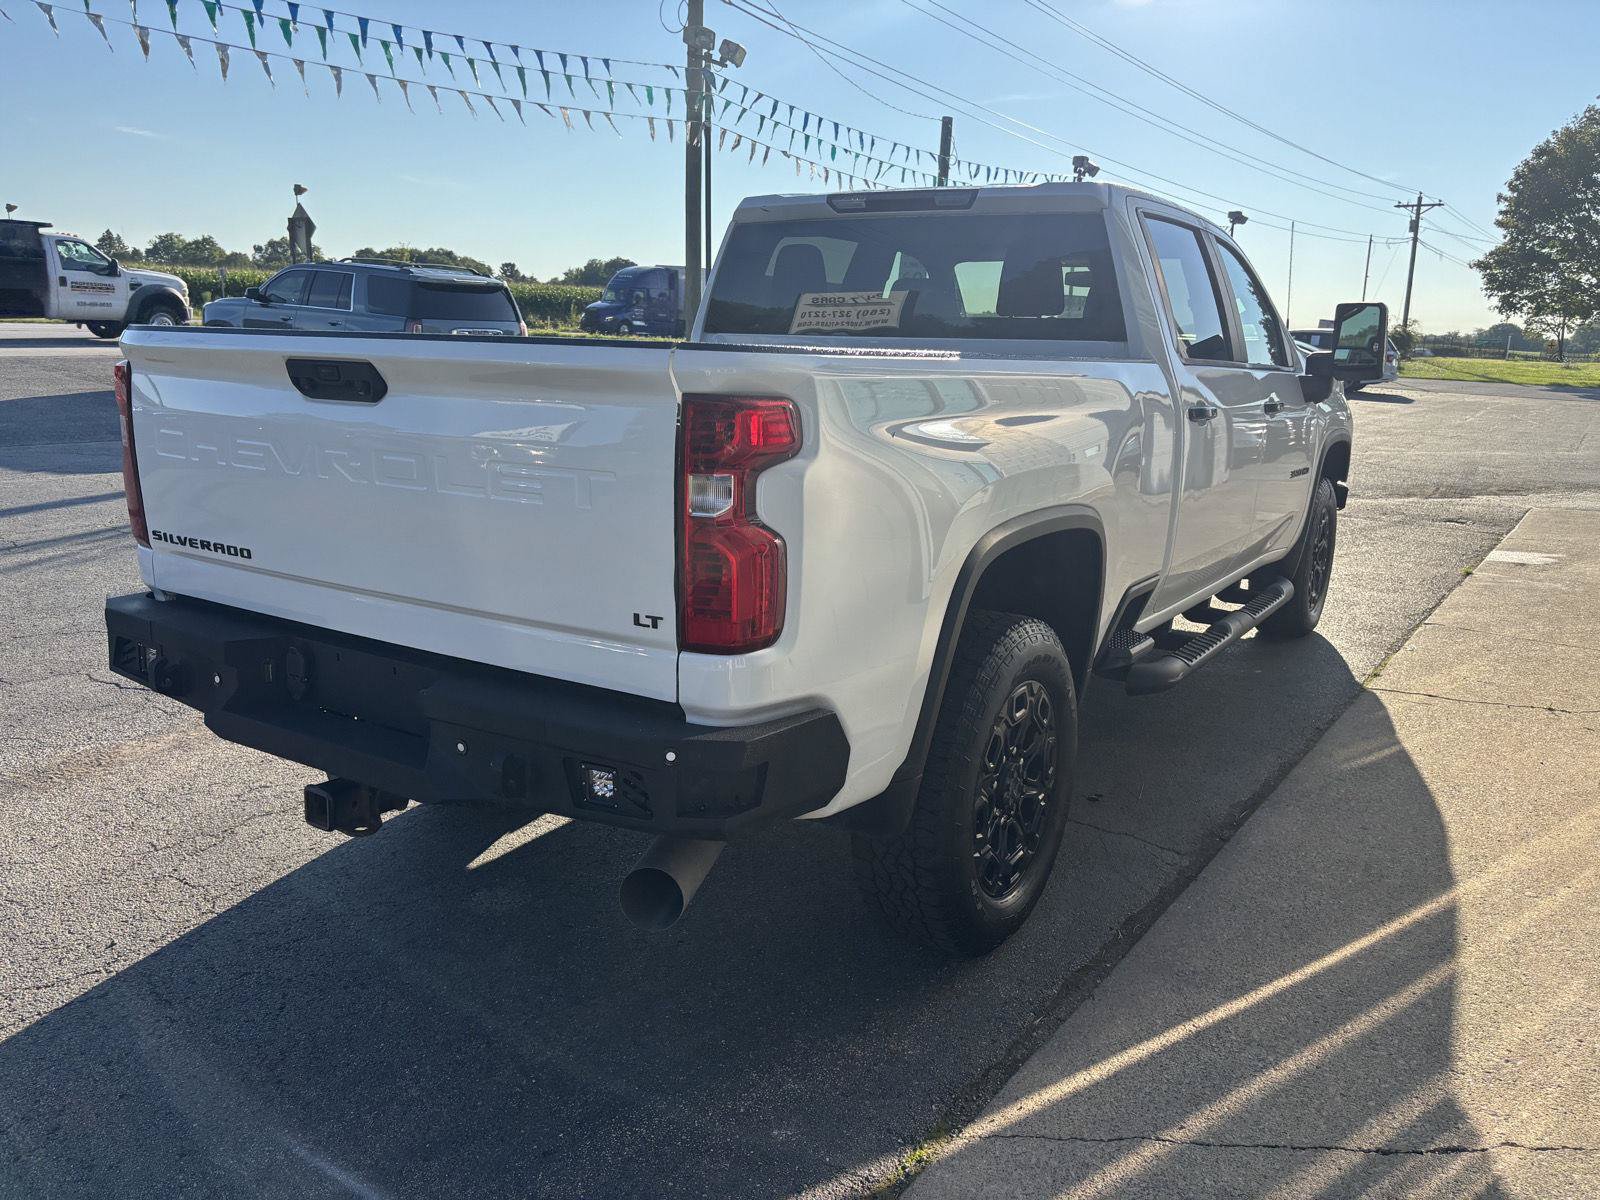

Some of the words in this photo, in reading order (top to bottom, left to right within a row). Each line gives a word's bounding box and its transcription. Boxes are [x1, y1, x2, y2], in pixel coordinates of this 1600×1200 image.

[154, 425, 617, 510] CHEVROLET
[152, 529, 252, 559] SILVERADO
[633, 612, 664, 629] LT
